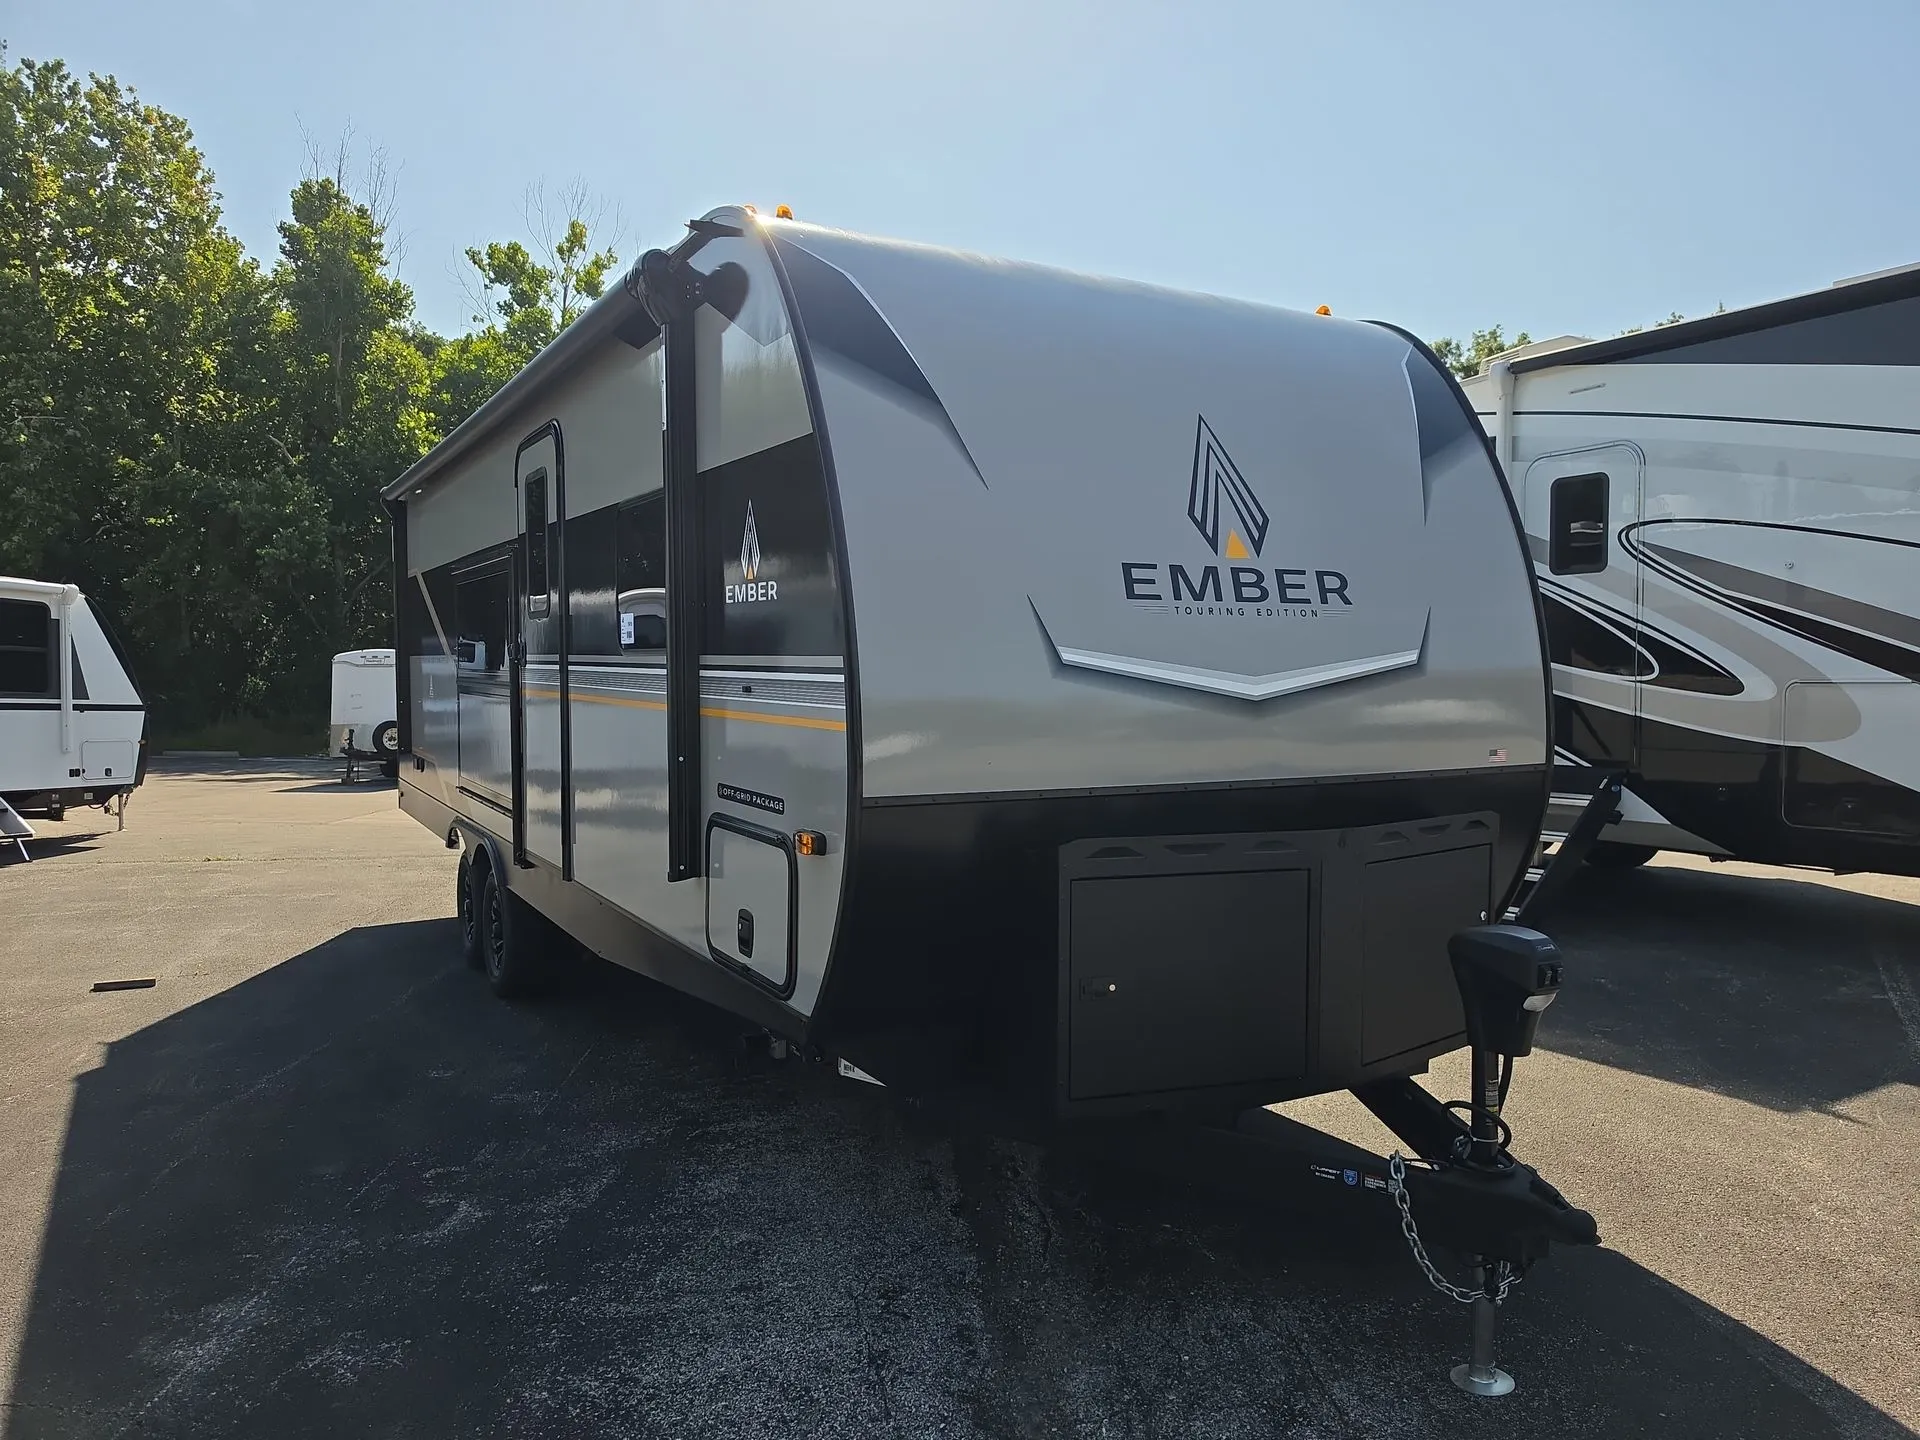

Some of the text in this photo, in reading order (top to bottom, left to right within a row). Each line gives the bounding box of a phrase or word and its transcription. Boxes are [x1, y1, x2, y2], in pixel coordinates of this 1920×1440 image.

[725, 580, 778, 604] EMBER
[1121, 562, 1353, 606] EMBER
[1174, 606, 1319, 618] TOURING EDITION
[723, 787, 784, 811] OFF-GRID PACKAGE
